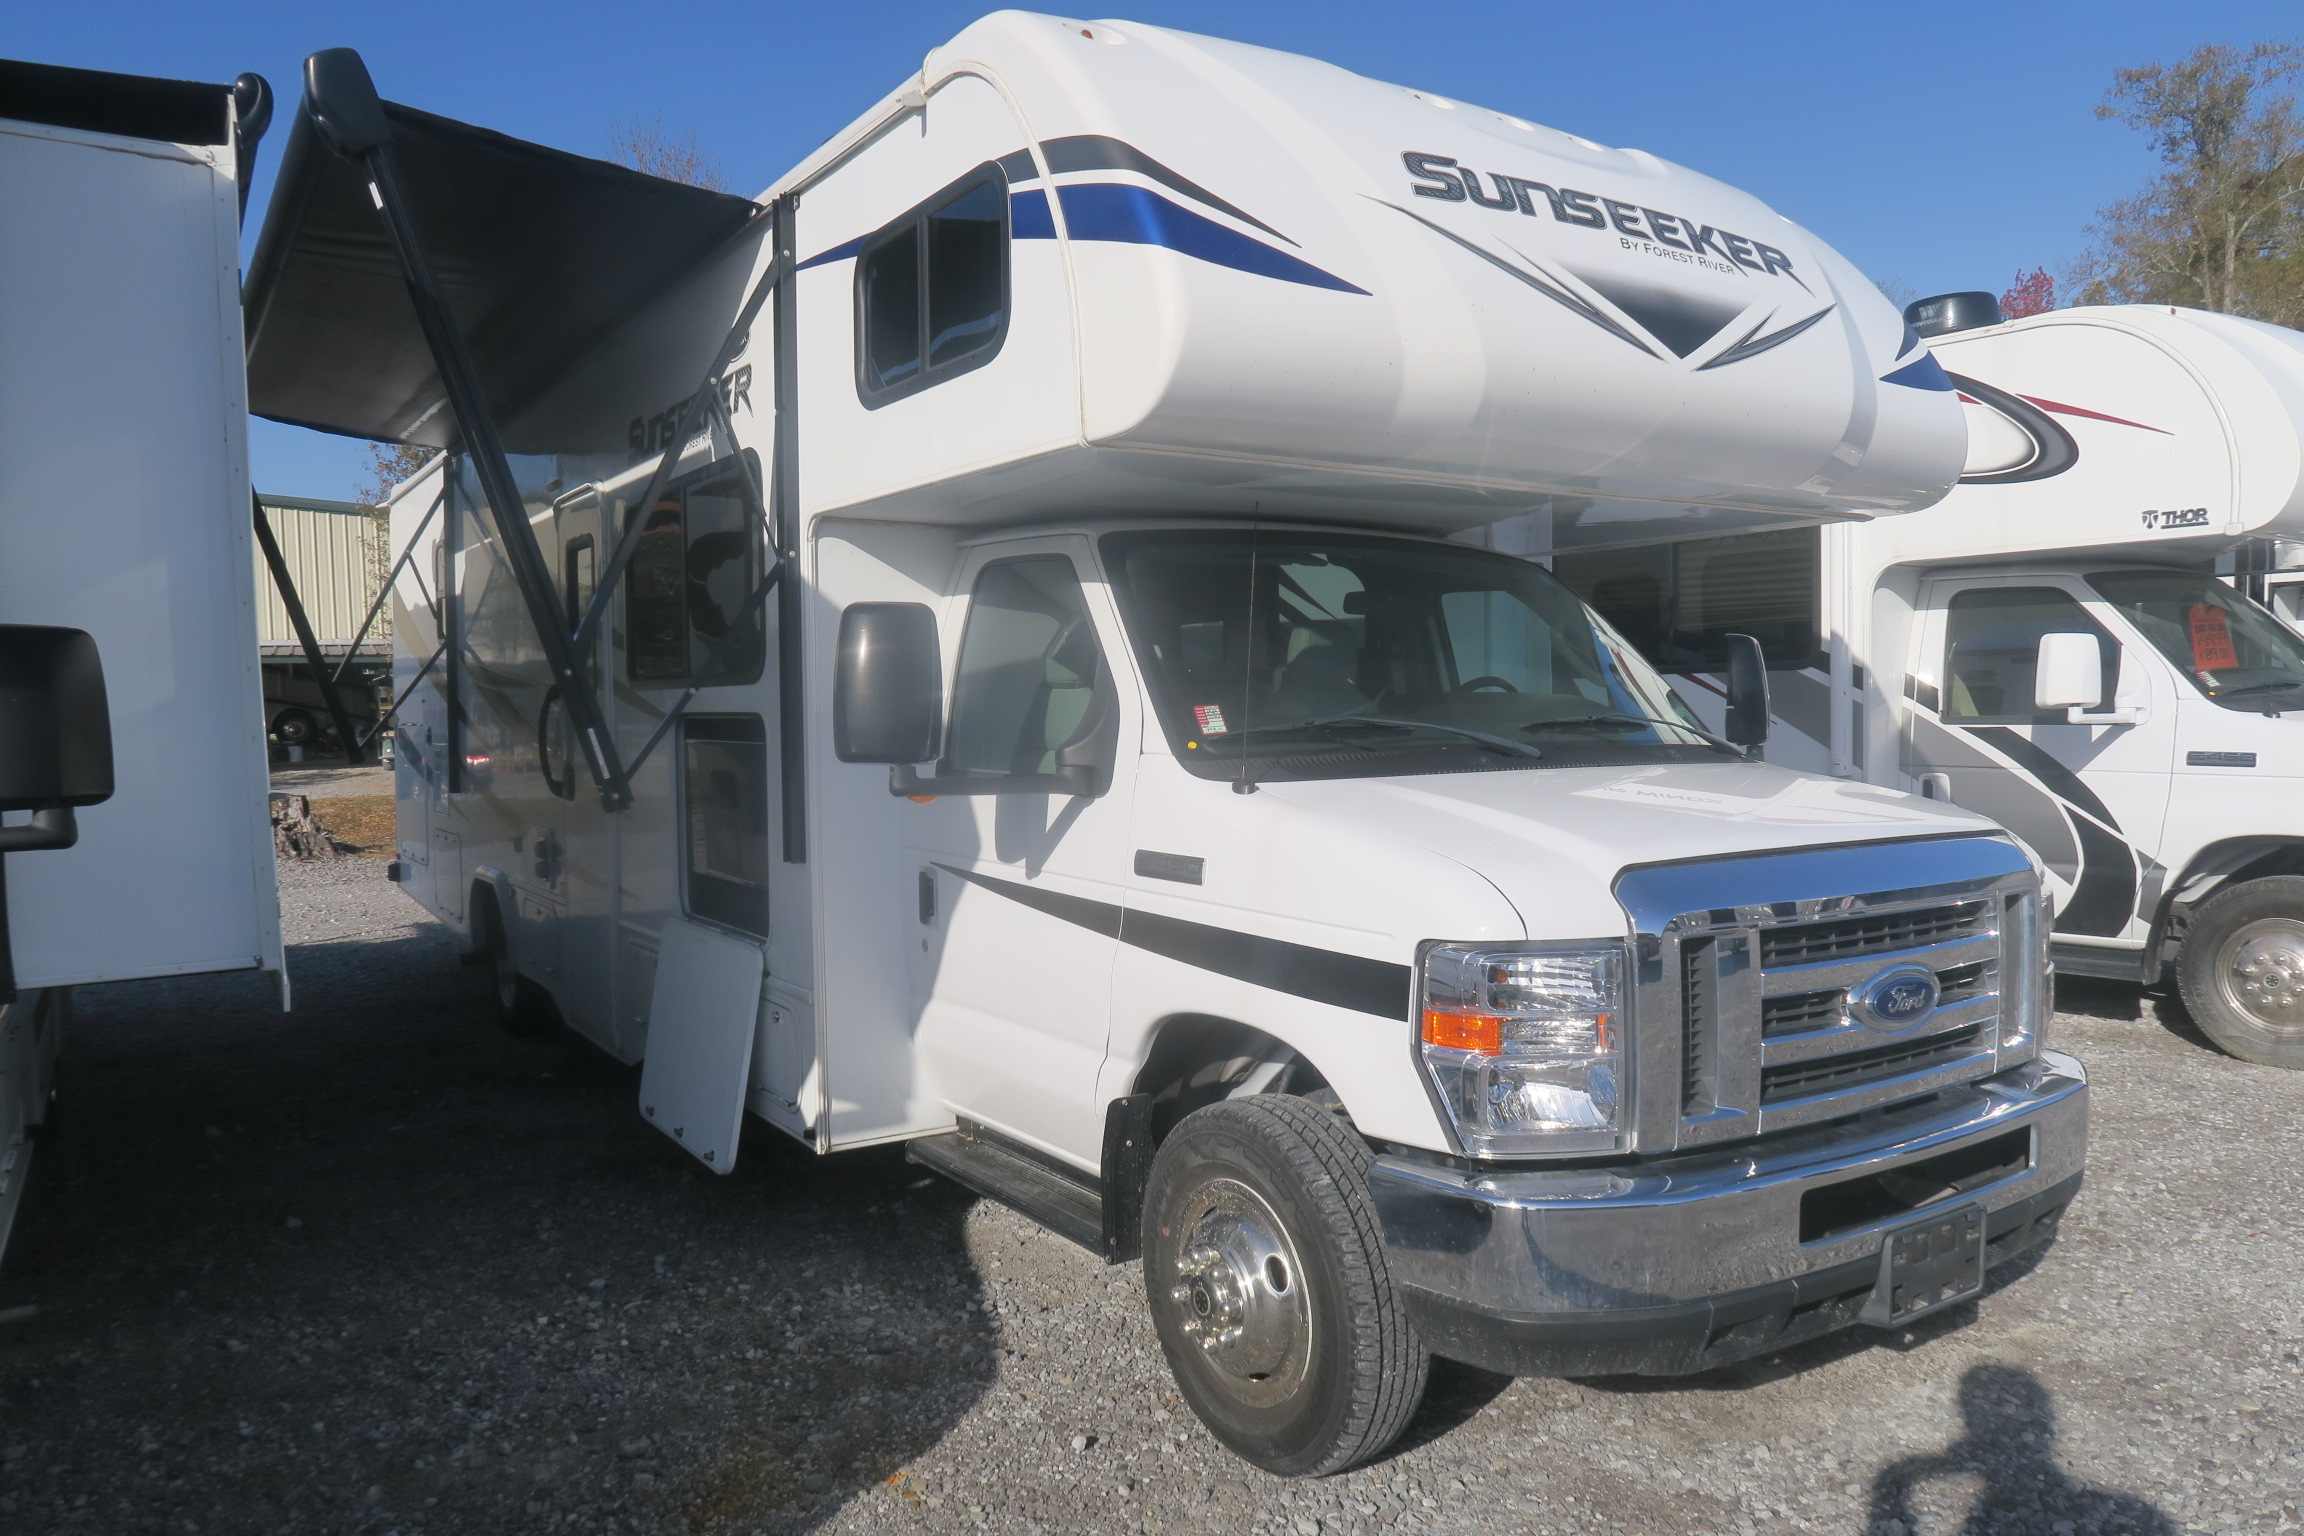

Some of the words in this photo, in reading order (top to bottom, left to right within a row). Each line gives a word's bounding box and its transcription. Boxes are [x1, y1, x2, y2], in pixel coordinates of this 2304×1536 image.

[1401, 150, 1816, 298] SUNSEEKER
[1620, 237, 1639, 251] BY
[1643, 243, 1694, 265] FOREST
[1698, 256, 1735, 275] RIVER
[2160, 507, 2208, 525] THOR
[1887, 984, 1926, 1014] Ford
